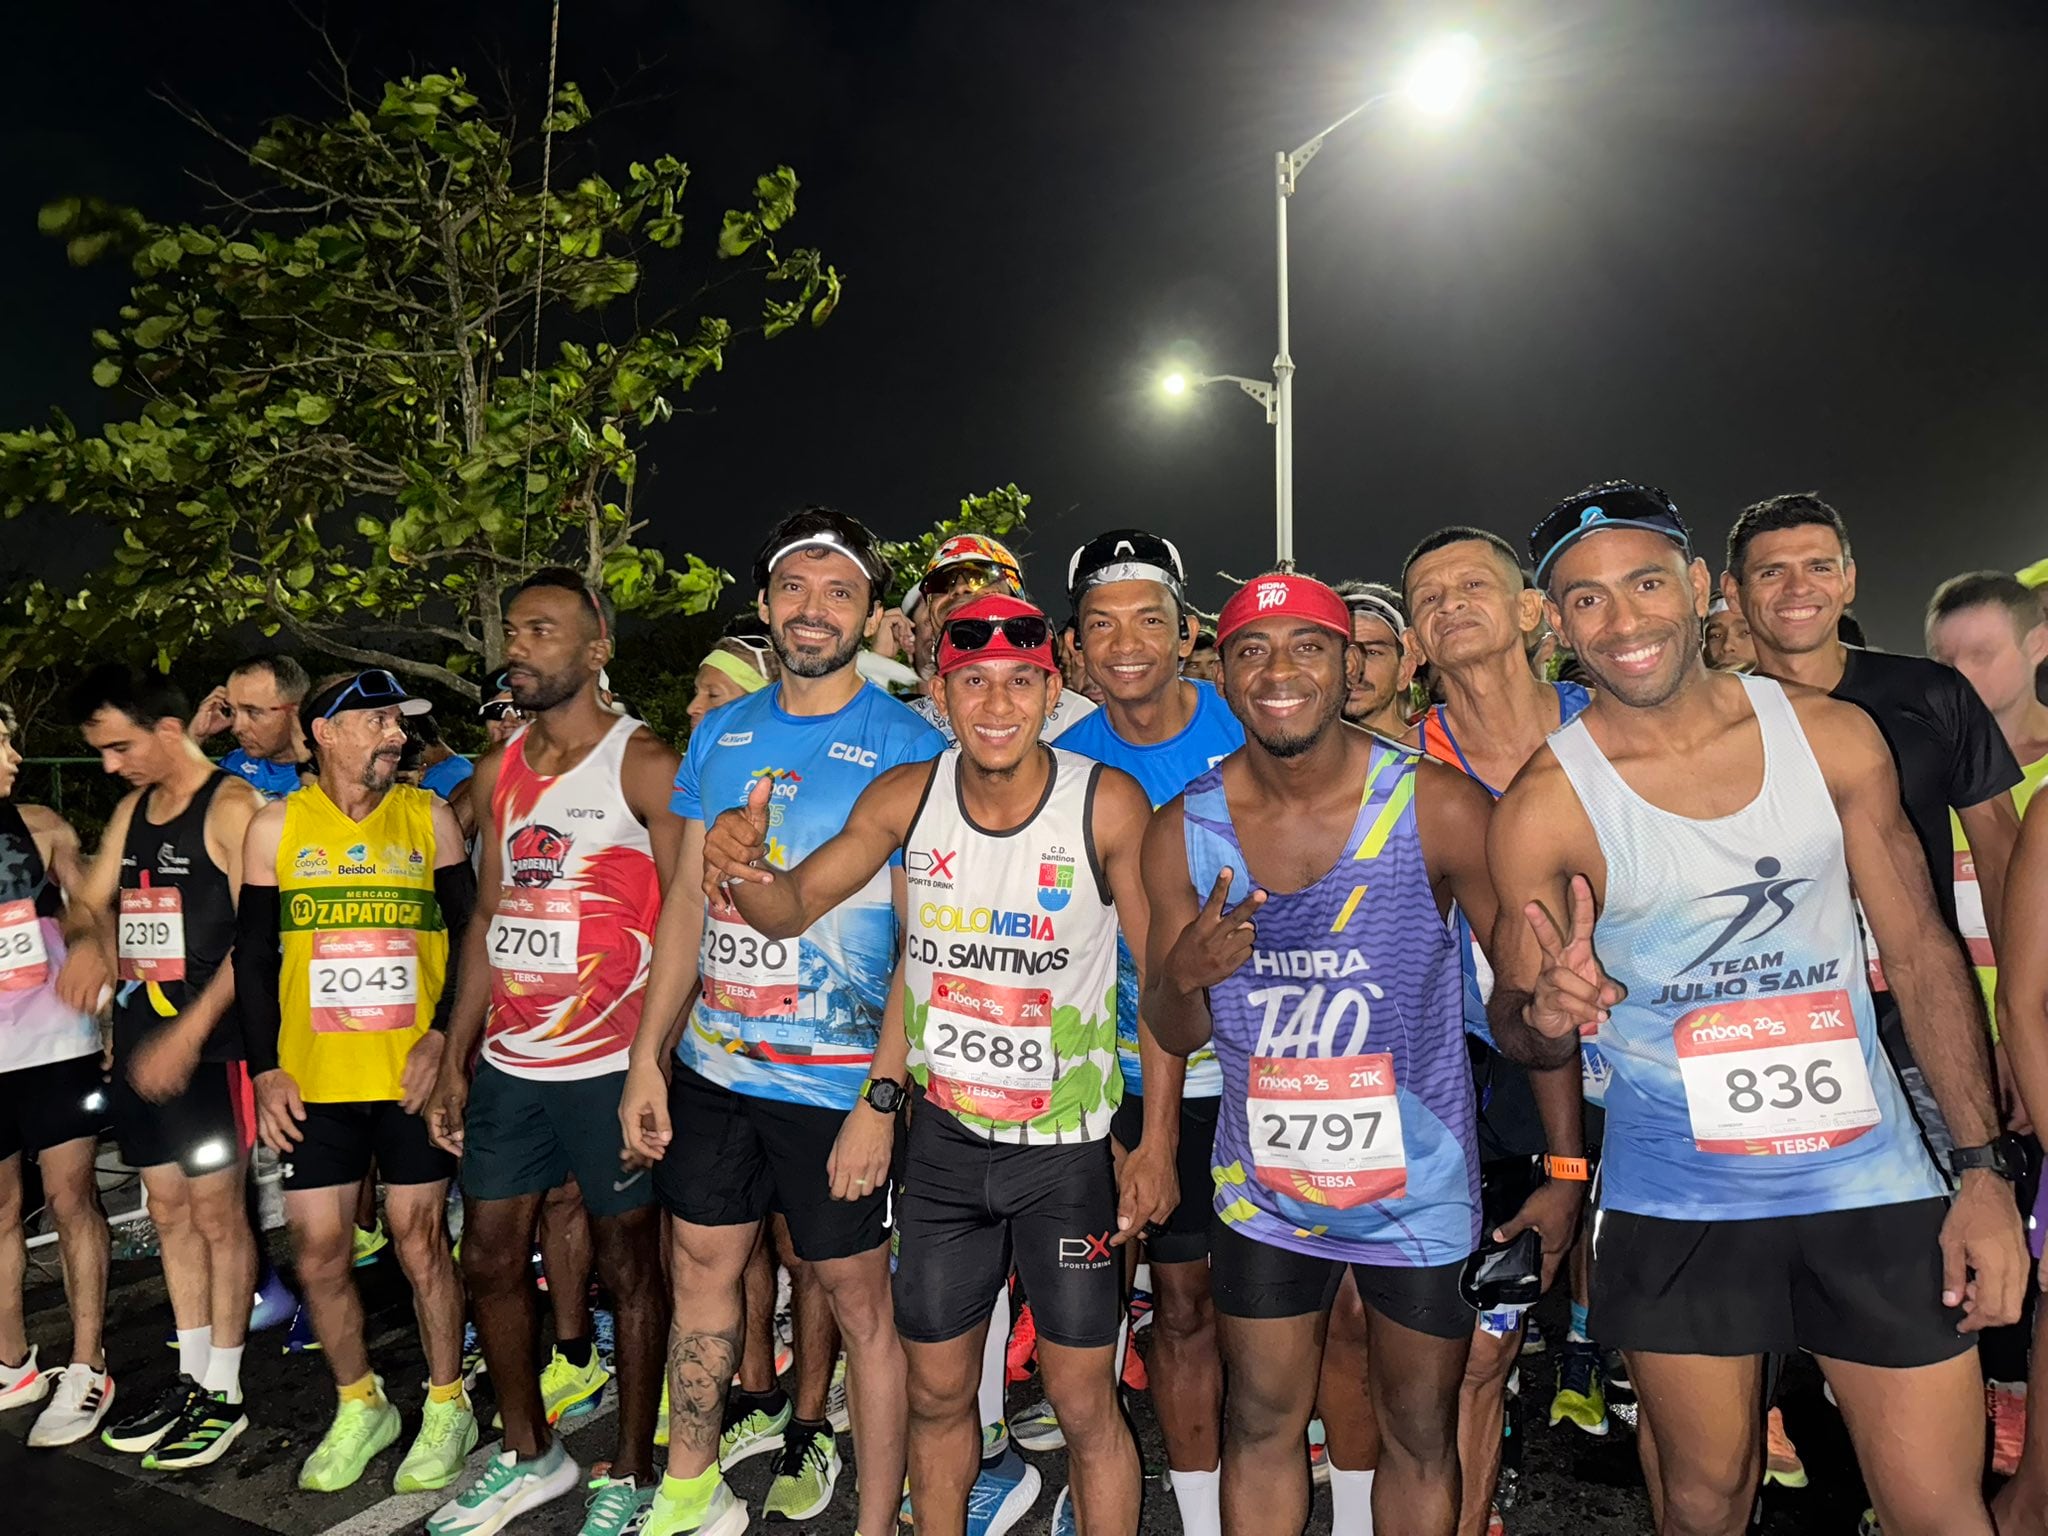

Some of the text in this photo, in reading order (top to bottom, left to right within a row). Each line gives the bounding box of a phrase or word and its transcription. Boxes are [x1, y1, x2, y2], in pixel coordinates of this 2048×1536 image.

[1256, 589, 1289, 612] TAO
[828, 741, 878, 768] CUC
[338, 864, 377, 875] Beisbol
[511, 858, 564, 879] CARDENAL
[908, 848, 957, 880] PX
[1041, 853, 1076, 863] Santinos
[346, 890, 399, 898] MERCADO
[908, 877, 955, 890] SPORTS DRINK
[317, 902, 423, 925] ZAPATOCA
[545, 901, 572, 913] 21K
[919, 902, 1055, 941] COLOMBIA
[125, 922, 169, 945] 2319
[495, 926, 560, 959] 2701
[708, 930, 788, 970] 2930
[908, 934, 1070, 976] C.D. SANTINOS
[1253, 948, 1371, 979] HIDRA
[1709, 950, 1784, 977] TEAM
[318, 965, 408, 993] 2043
[513, 972, 544, 983] TEBSA
[1651, 958, 1840, 1005] JULIO SANZ
[725, 984, 757, 999] TEBSA
[1020, 1004, 1043, 1017] 21K
[1247, 983, 1382, 1058] TAO
[1808, 1009, 1844, 1030] 21K
[1692, 1022, 1754, 1043] mbaq
[934, 1023, 1043, 1072] 2688
[1349, 1071, 1384, 1088] 21K
[1726, 1059, 1842, 1113] 836
[966, 1085, 1006, 1099] TEBSA
[1262, 1111, 1382, 1151] 2797
[1771, 1136, 1830, 1155] TEBSA
[1309, 1174, 1356, 1188] TEBSA
[1059, 1231, 1111, 1261] PX
